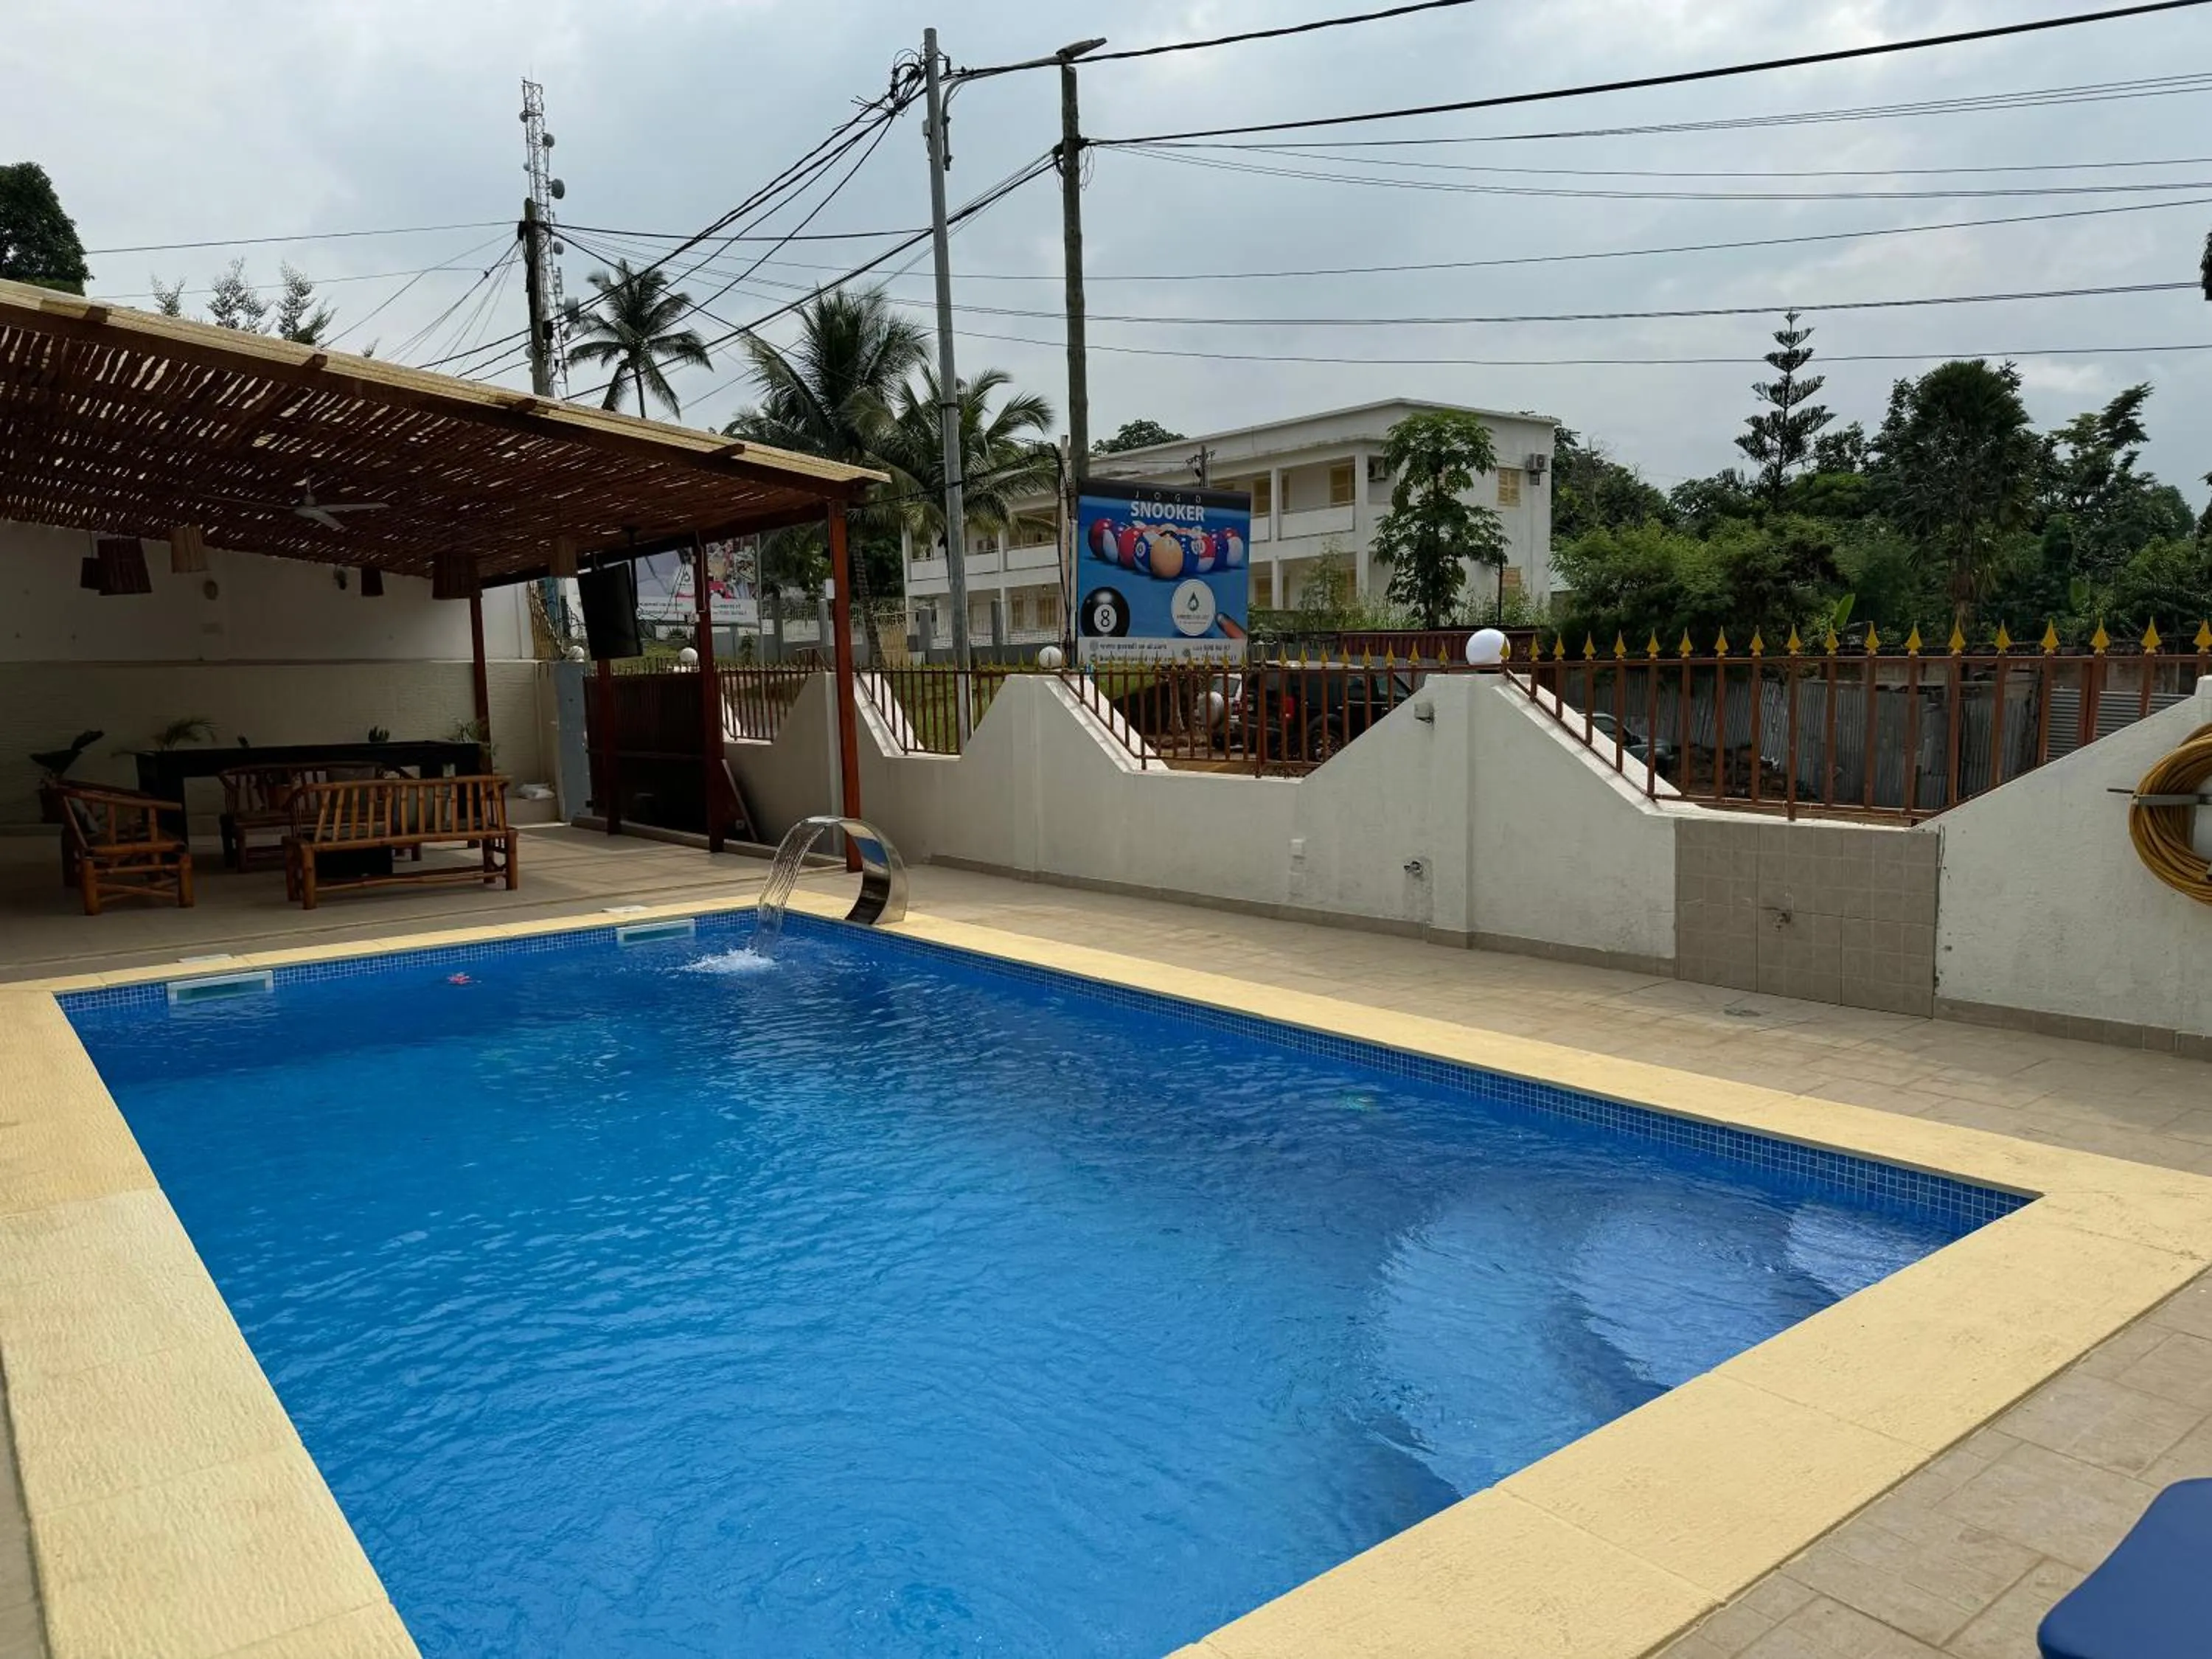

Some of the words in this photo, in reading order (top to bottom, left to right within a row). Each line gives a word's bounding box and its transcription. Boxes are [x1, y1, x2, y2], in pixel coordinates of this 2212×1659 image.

[1134, 490, 1201, 503] JOGO
[1130, 501, 1206, 521] SNOOKER
[1101, 609, 1110, 627] 8
